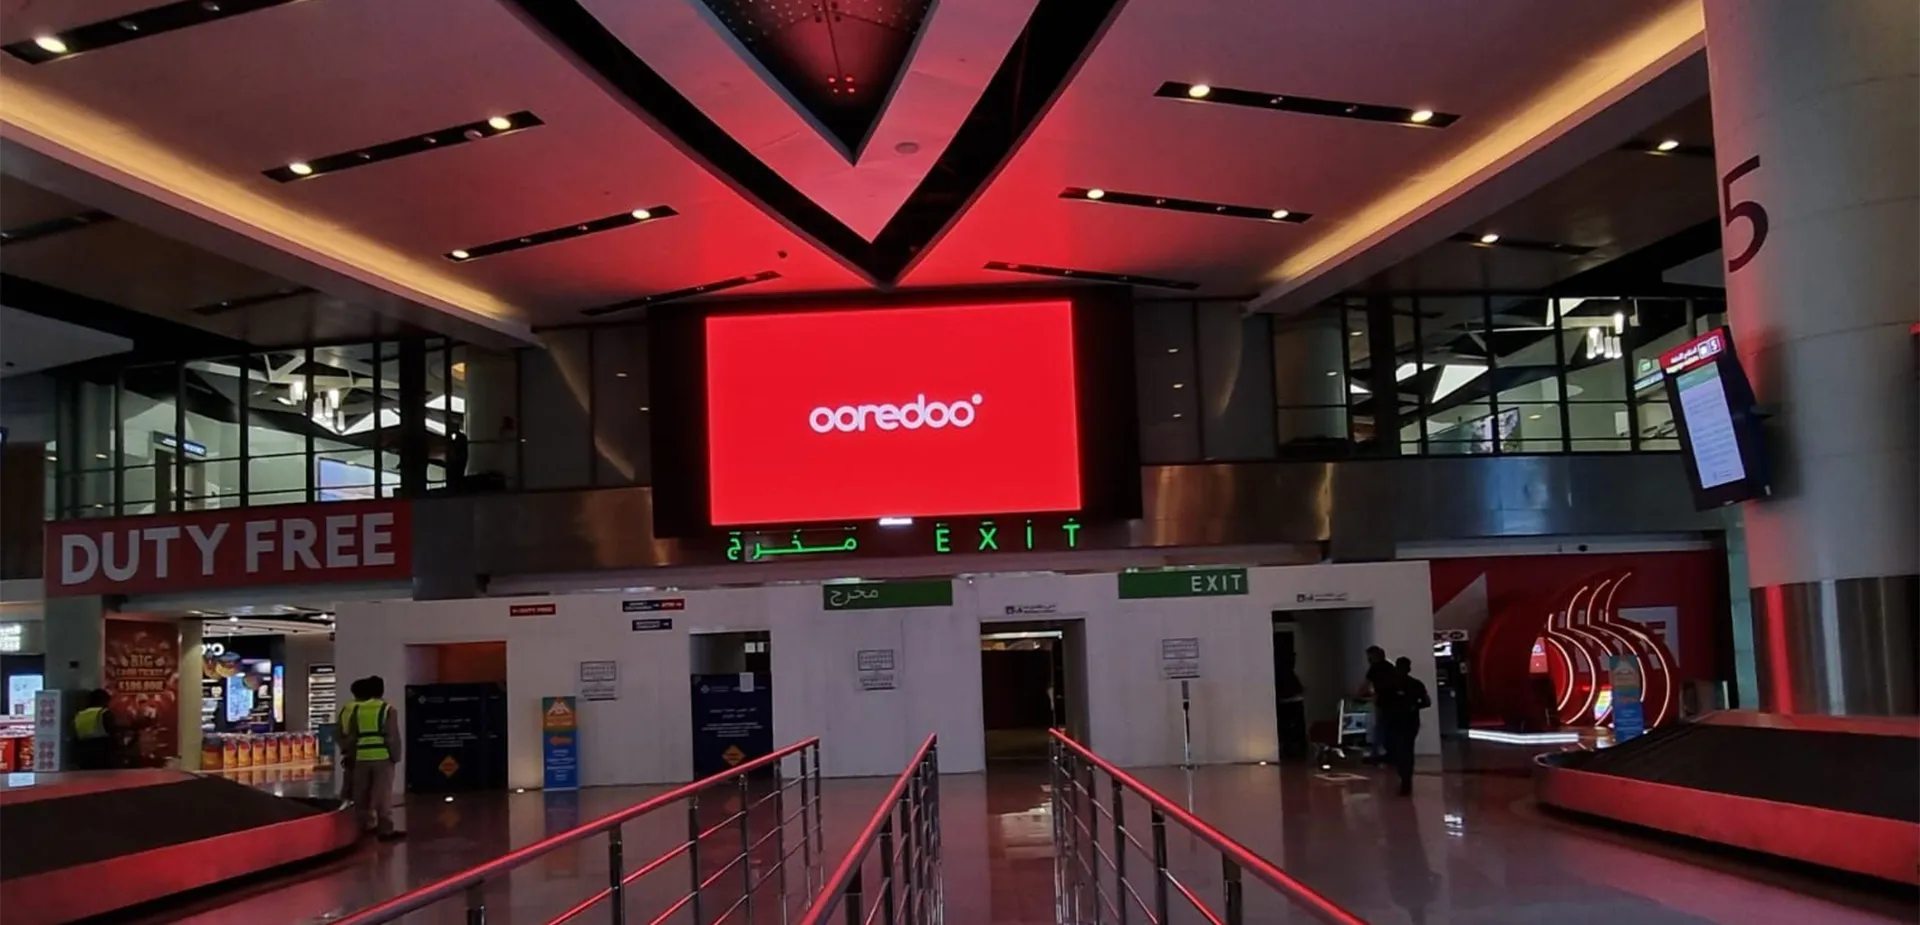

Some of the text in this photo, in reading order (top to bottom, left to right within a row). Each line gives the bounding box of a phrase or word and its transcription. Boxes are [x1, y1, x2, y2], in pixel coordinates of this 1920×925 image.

[1721, 155, 1769, 273] 5
[809, 394, 982, 433] ooredoo
[61, 512, 395, 585] DUTY FREE
[727, 533, 858, 560] مخرج
[935, 522, 1081, 552] EXIT
[829, 587, 880, 607] مخرج
[1191, 573, 1245, 594] EXIT
